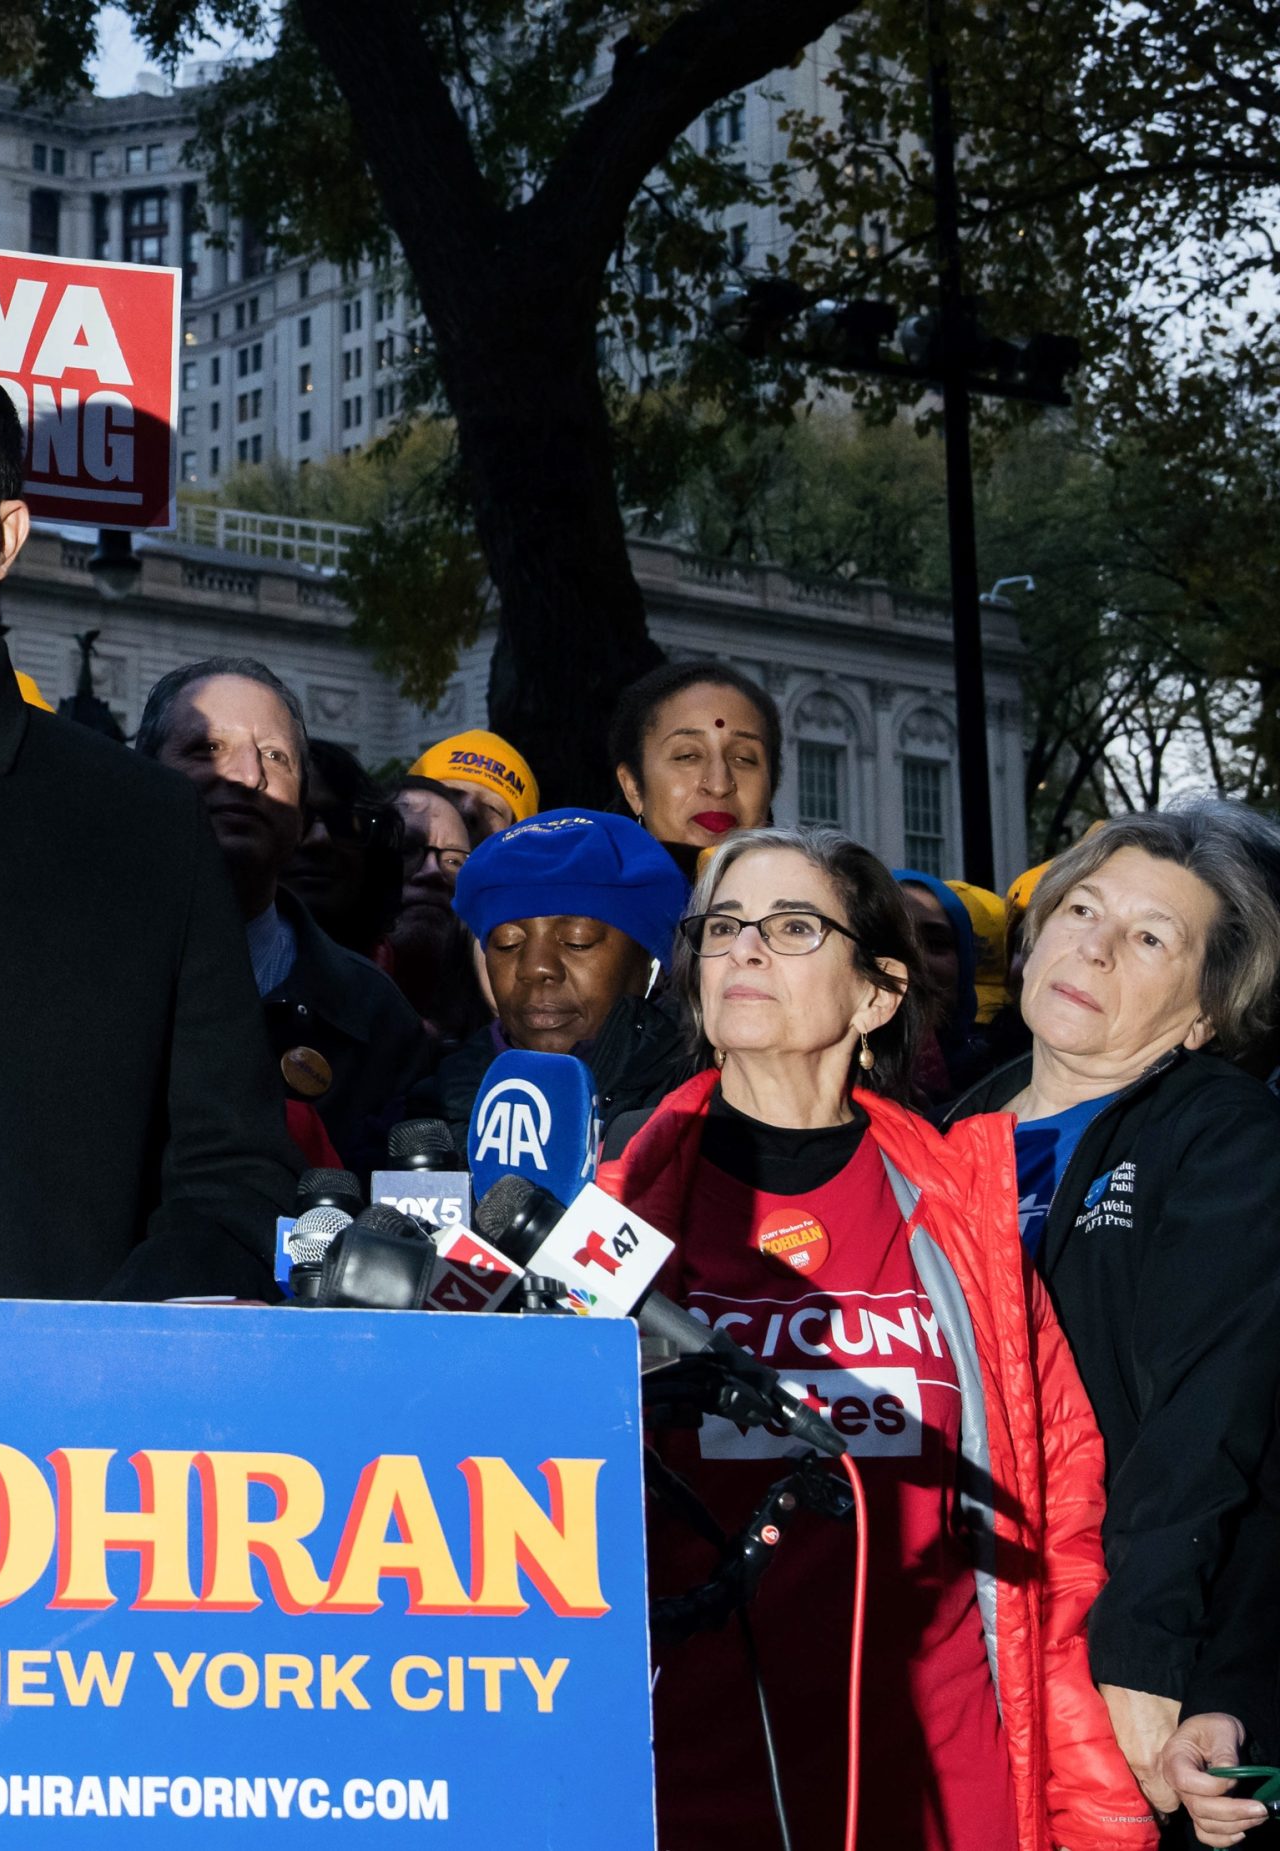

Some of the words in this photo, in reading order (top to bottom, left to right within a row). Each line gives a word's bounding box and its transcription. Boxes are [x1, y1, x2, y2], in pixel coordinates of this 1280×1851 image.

[448, 751, 526, 796] ZOHRAN
[475, 1101, 548, 1171] AA
[1117, 1161, 1136, 1171] duc
[1102, 1200, 1132, 1214] Wein
[760, 1230, 778, 1241] CUNY
[1084, 1215, 1103, 1234] AFT
[611, 1222, 640, 1259] 47
[154, 1652, 371, 1710] YORK
[390, 1655, 570, 1713] CITY
